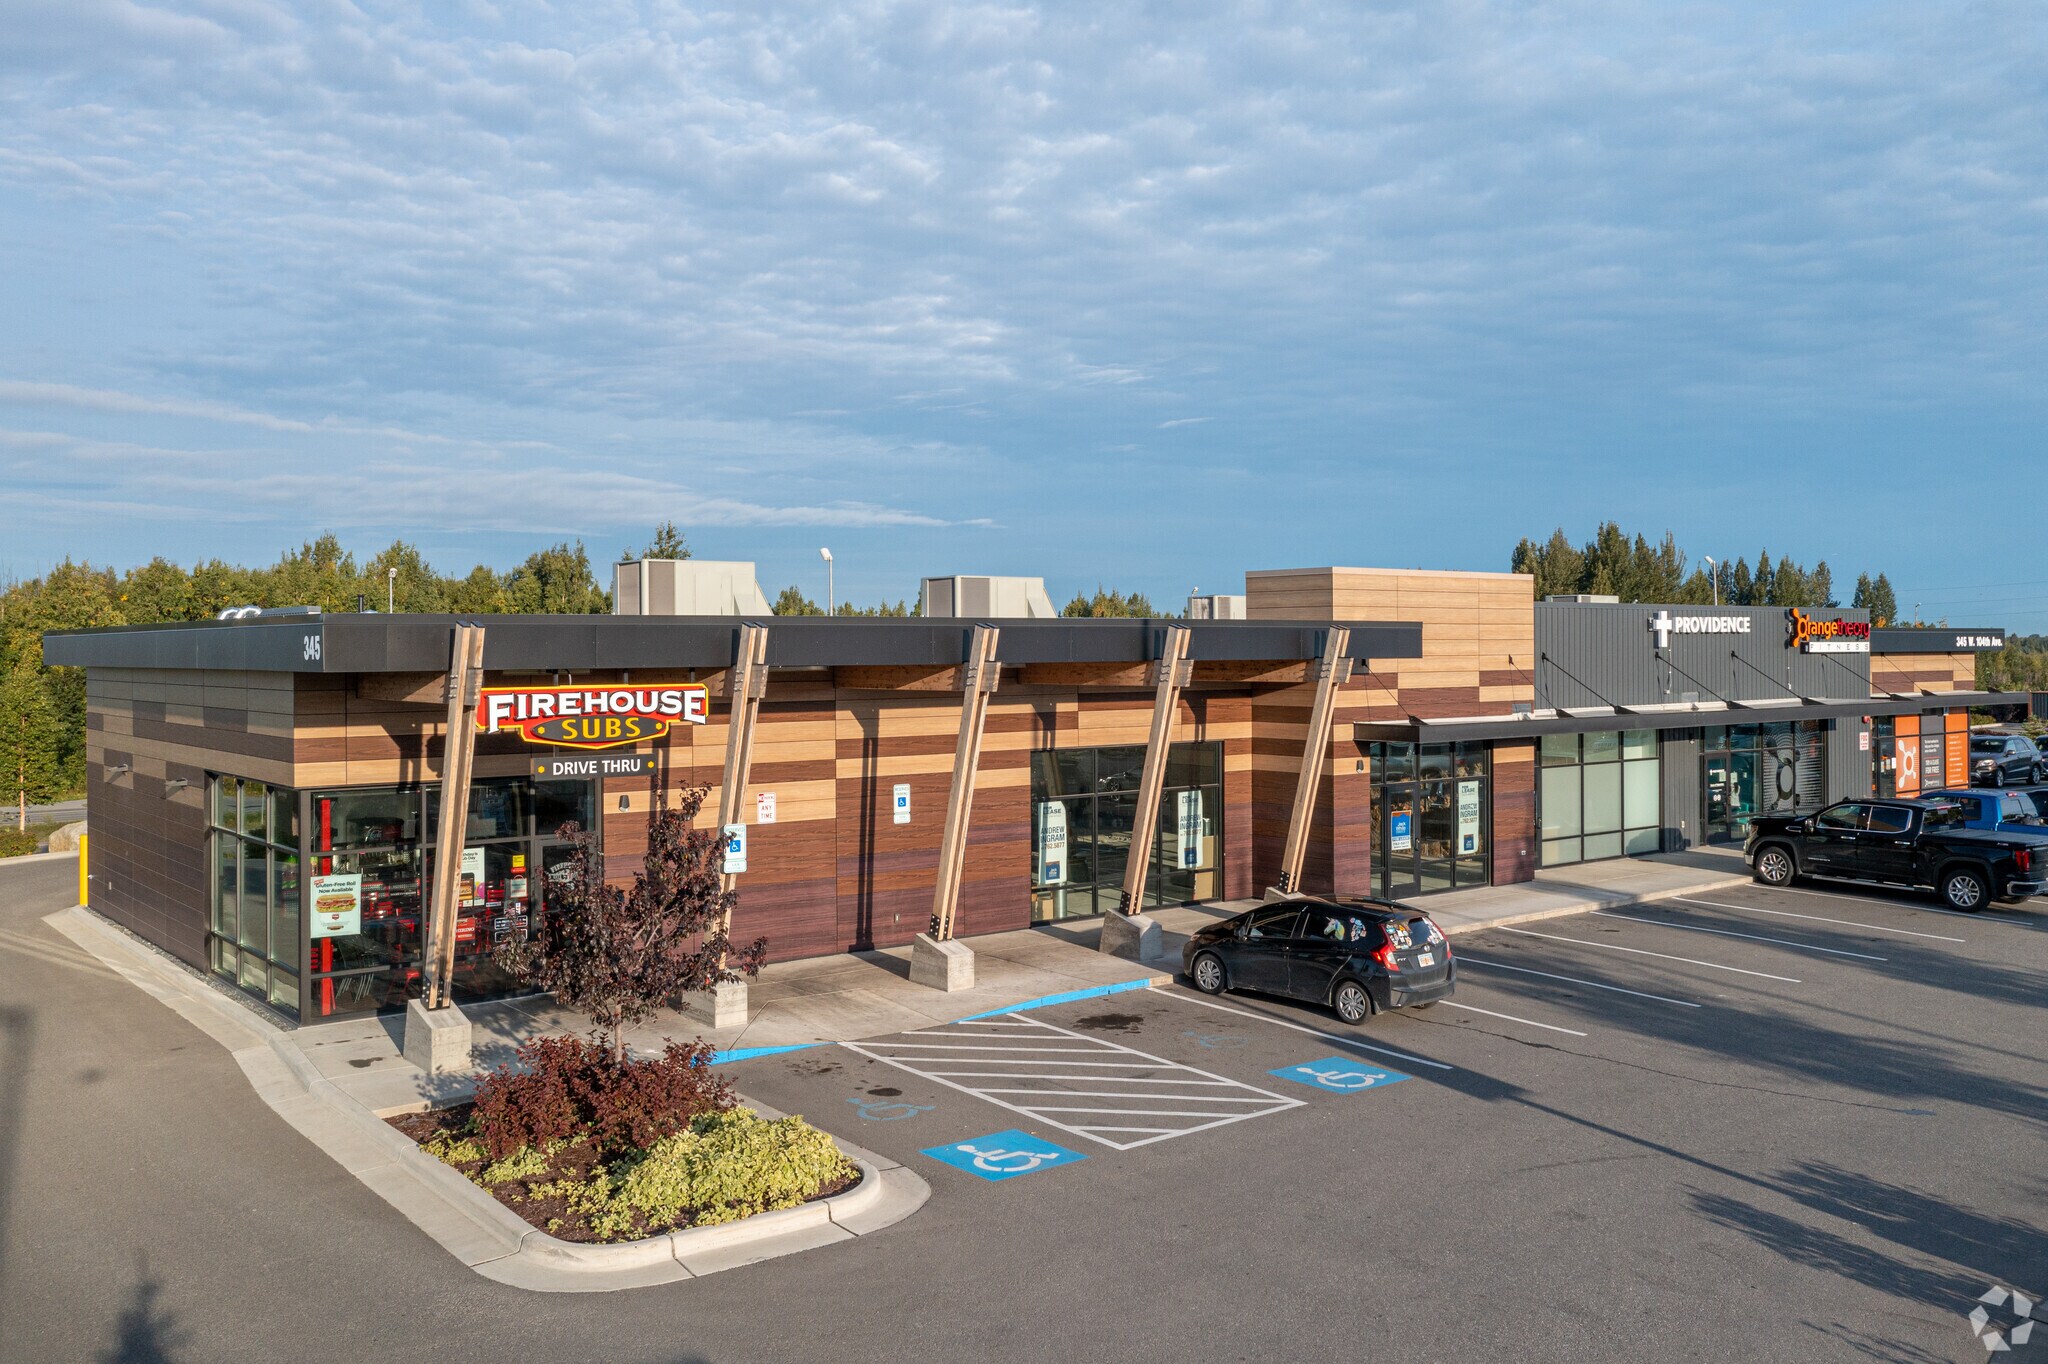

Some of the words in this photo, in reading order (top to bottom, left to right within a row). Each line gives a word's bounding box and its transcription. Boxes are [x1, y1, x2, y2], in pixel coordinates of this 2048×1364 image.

[1675, 616, 1750, 633] PROVIDENCE
[1794, 612, 1871, 641] Orangetheory
[303, 635, 320, 660] 345
[1810, 643, 1869, 651] FITNESS
[1956, 636, 1967, 647] 345
[1976, 636, 1991, 647] 104th
[1991, 636, 2003, 647] Ave.
[488, 689, 706, 734] FIREHOUSE
[561, 717, 641, 740] SUBS
[552, 761, 597, 776] DRIVE
[602, 758, 641, 773] THRU
[761, 812, 773, 820] TIME
[1460, 810, 1477, 818] INGRAM
[1041, 826, 1065, 835] ANDREW
[1041, 833, 1065, 843] INGRAM
